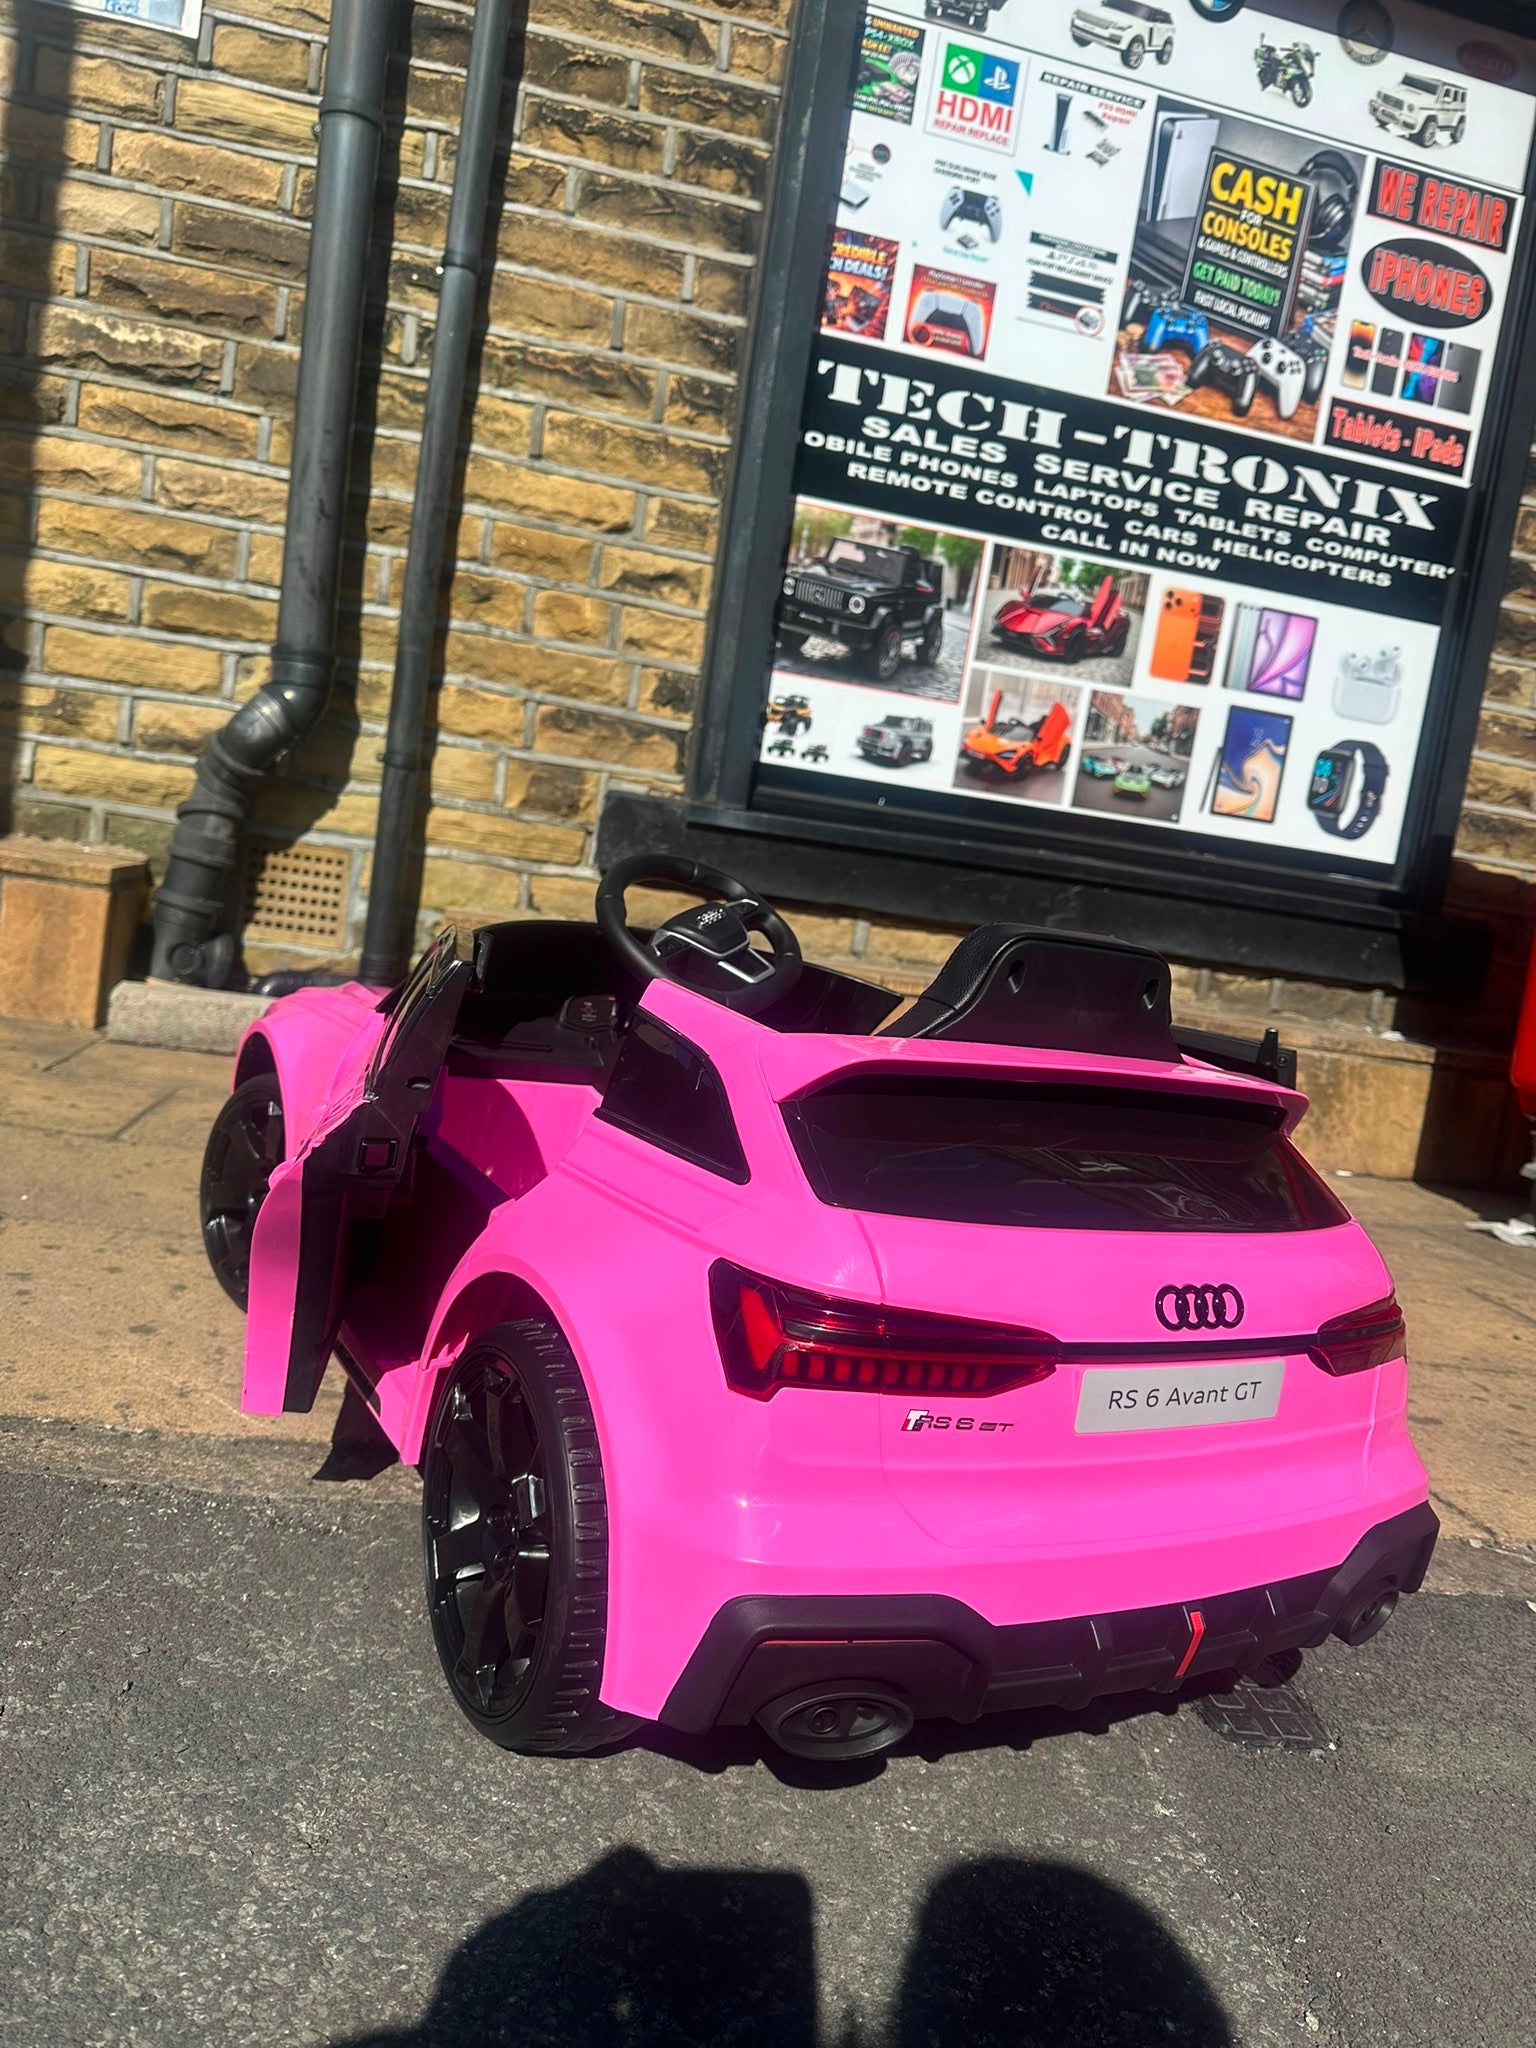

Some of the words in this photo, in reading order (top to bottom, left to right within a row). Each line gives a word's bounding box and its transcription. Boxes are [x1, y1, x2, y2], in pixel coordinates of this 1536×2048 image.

[933, 118, 967, 138] REPAIR
[967, 126, 1010, 147] REPLACE
[935, 91, 1015, 134] HDMI
[1211, 161, 1304, 226] CASH
[1240, 210, 1264, 227] FOR
[1377, 163, 1417, 221] WE
[1417, 179, 1508, 249] REPAIR
[1202, 210, 1293, 262] CONSOLES
[1192, 261, 1215, 283] GET
[1213, 267, 1242, 292] PAID
[1241, 275, 1281, 307] TODAY!
[1368, 249, 1487, 320] iPHONES
[817, 359, 1439, 531] TECH-TRONIX
[1332, 406, 1402, 453] Tablets
[1411, 426, 1464, 468] iPads
[803, 430, 892, 462] OBILE
[900, 450, 1019, 489] PHONES
[1034, 478, 1159, 518] LAPTOPS
[1174, 508, 1292, 546] TABLETS
[1305, 536, 1456, 580] COMPUTER
[862, 415, 1008, 463] SALES
[1033, 452, 1221, 511] SERVICE
[1244, 498, 1392, 547] REPAIR
[847, 462, 968, 501] REMOTE
[975, 488, 1110, 528] CONTROL
[1124, 519, 1199, 547] CARS
[1211, 537, 1393, 588] HELICOPTERS
[1041, 523, 1112, 551] CALL
[1119, 539, 1149, 558] IN
[1156, 547, 1221, 573] NOW
[955, 1417, 975, 1431] 6
[1108, 1390, 1138, 1410] RS
[1146, 1389, 1160, 1408] 6
[1165, 1387, 1229, 1407] Avant
[1234, 1381, 1262, 1401] GT
